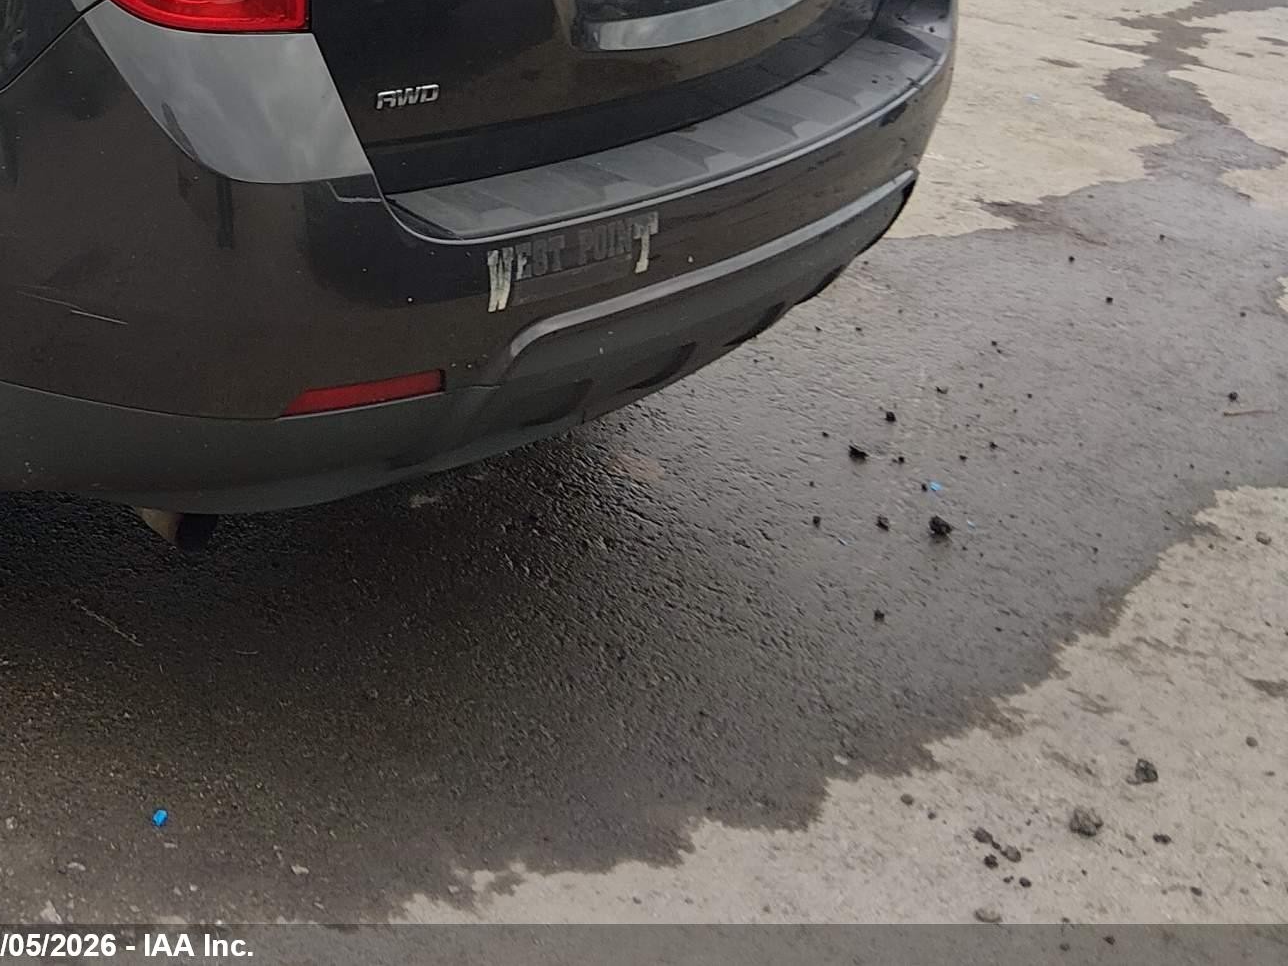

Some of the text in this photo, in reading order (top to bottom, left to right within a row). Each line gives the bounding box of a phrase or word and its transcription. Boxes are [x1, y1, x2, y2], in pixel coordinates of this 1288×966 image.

[376, 84, 440, 110] AWD
[487, 211, 659, 309] WEST POINT
